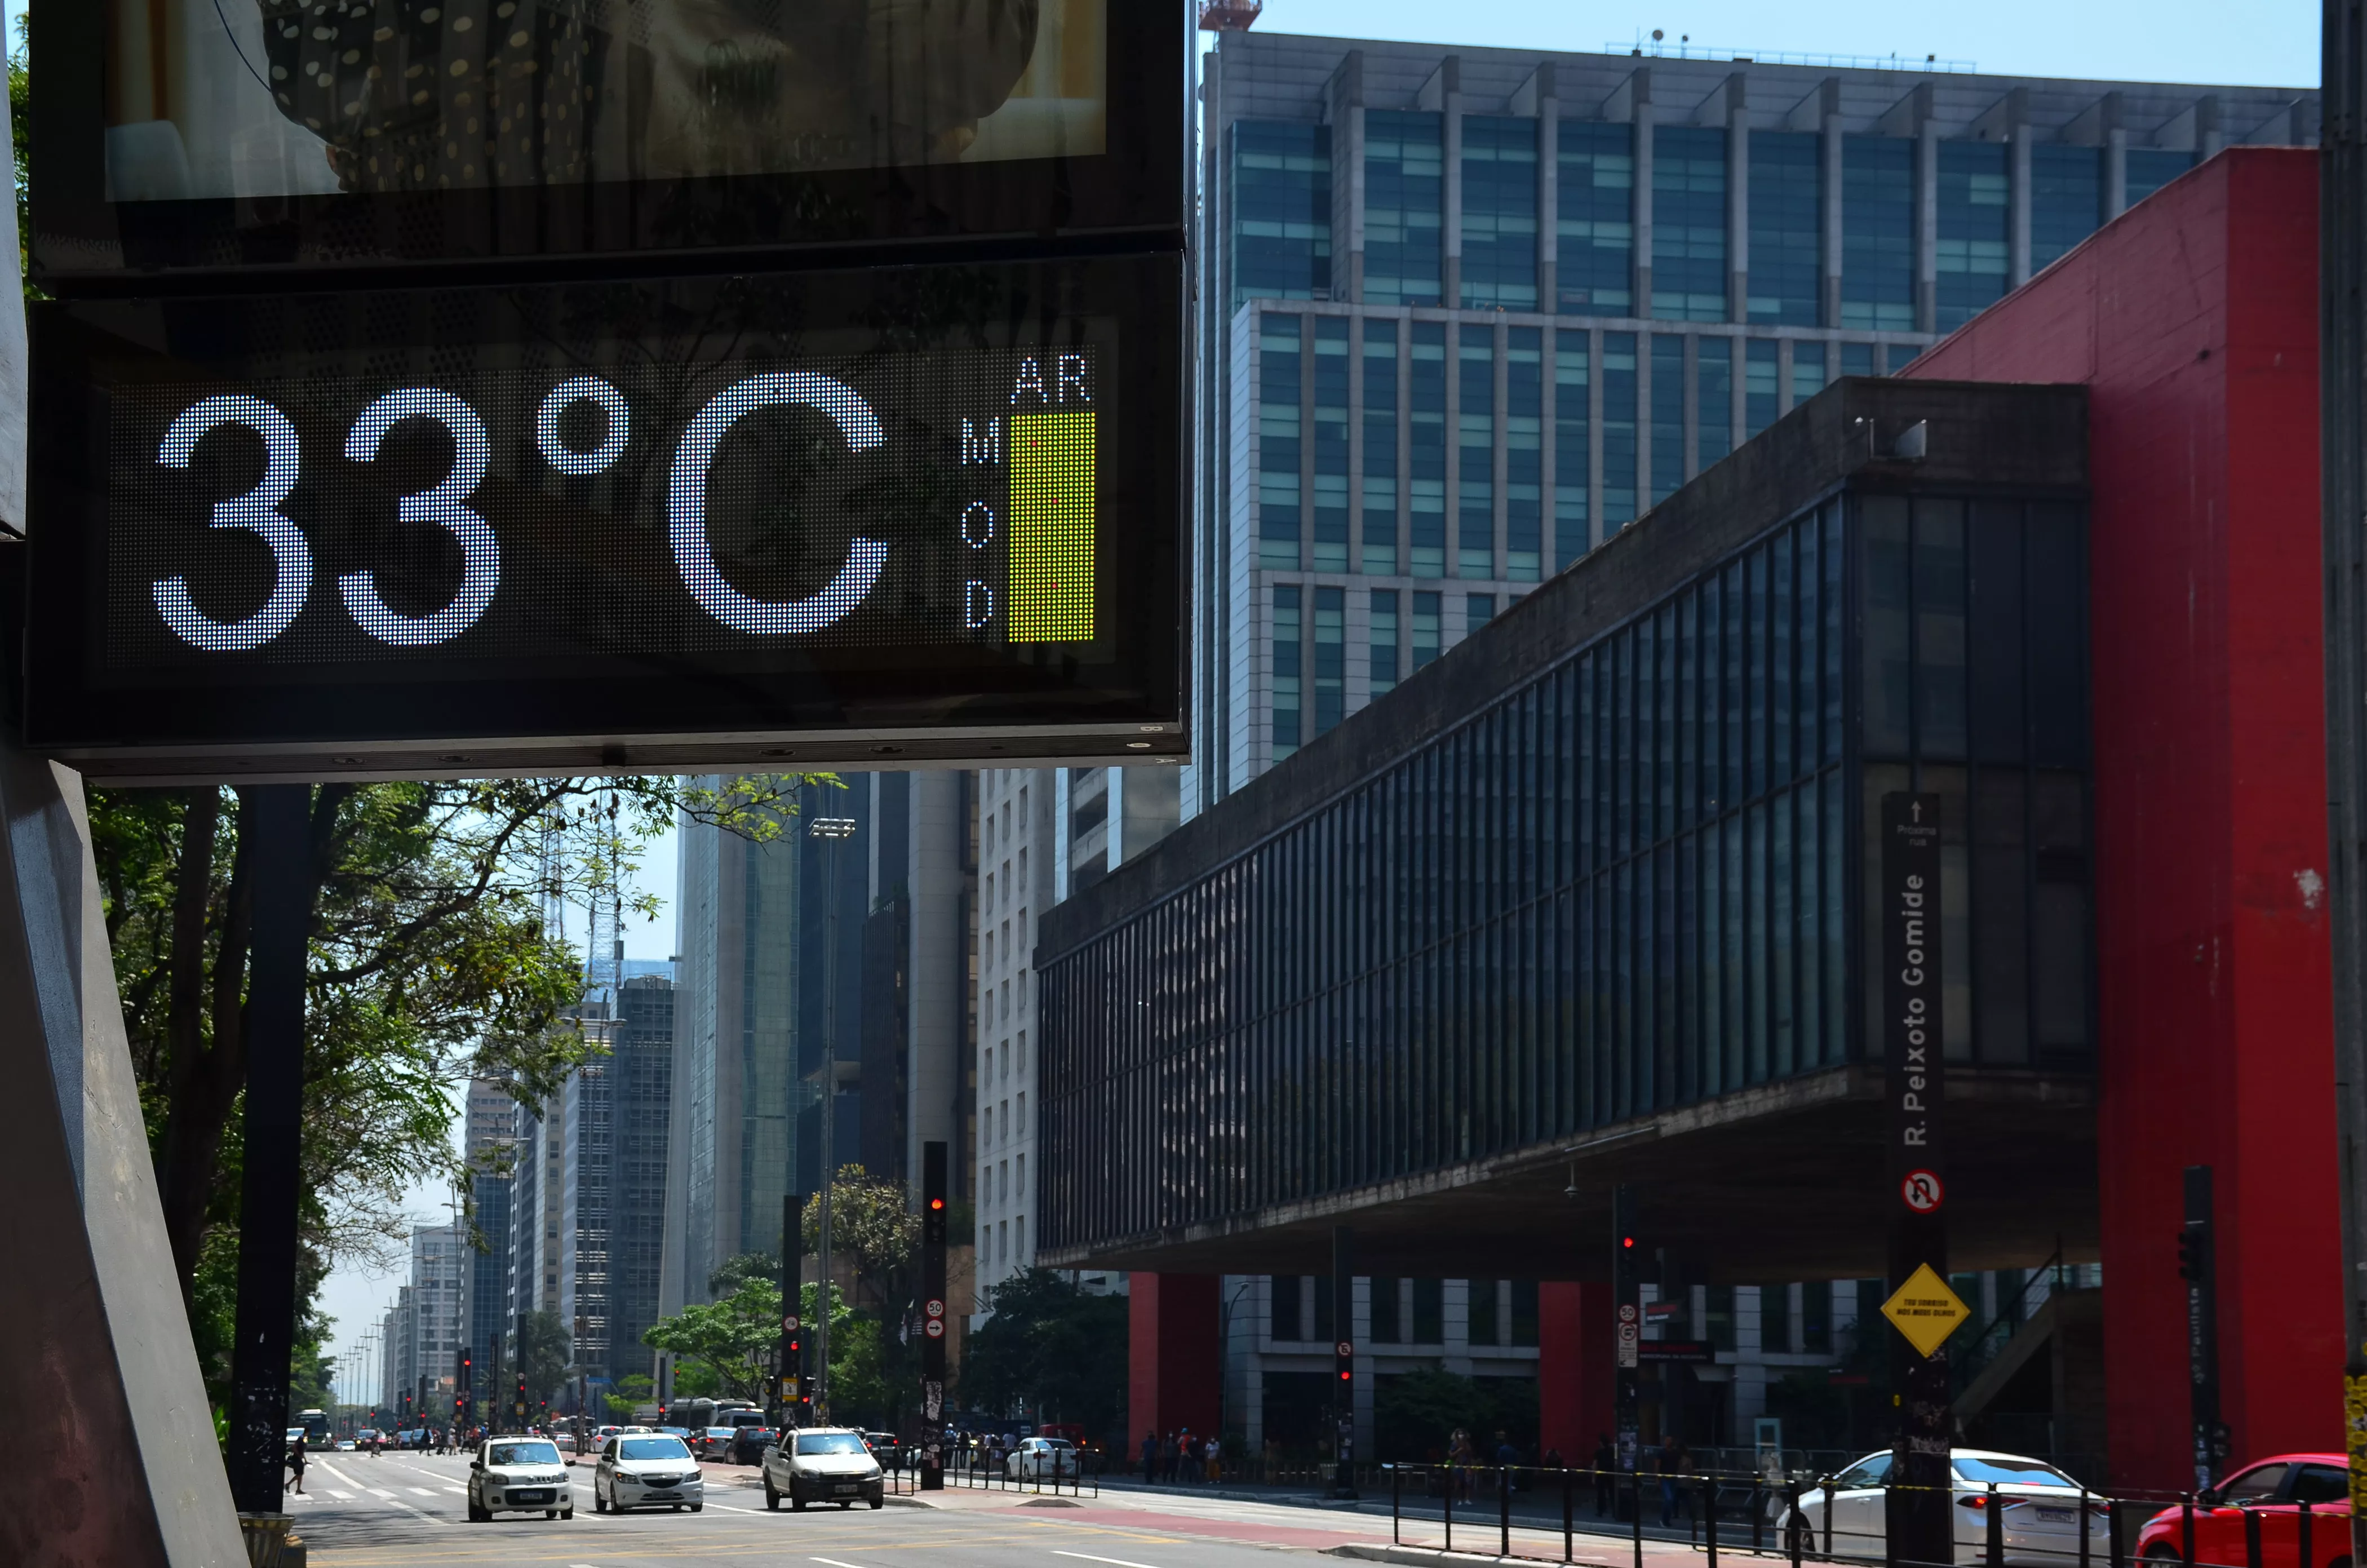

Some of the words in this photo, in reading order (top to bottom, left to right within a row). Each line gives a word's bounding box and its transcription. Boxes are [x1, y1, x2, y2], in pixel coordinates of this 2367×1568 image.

[1010, 355, 1091, 405] AR
[153, 372, 888, 650] 33°C
[1901, 874, 1925, 986] Gomide
[1903, 997, 1926, 1111] Peixoto
[1904, 1120, 1927, 1146] R.
[929, 1303, 941, 1312] 50
